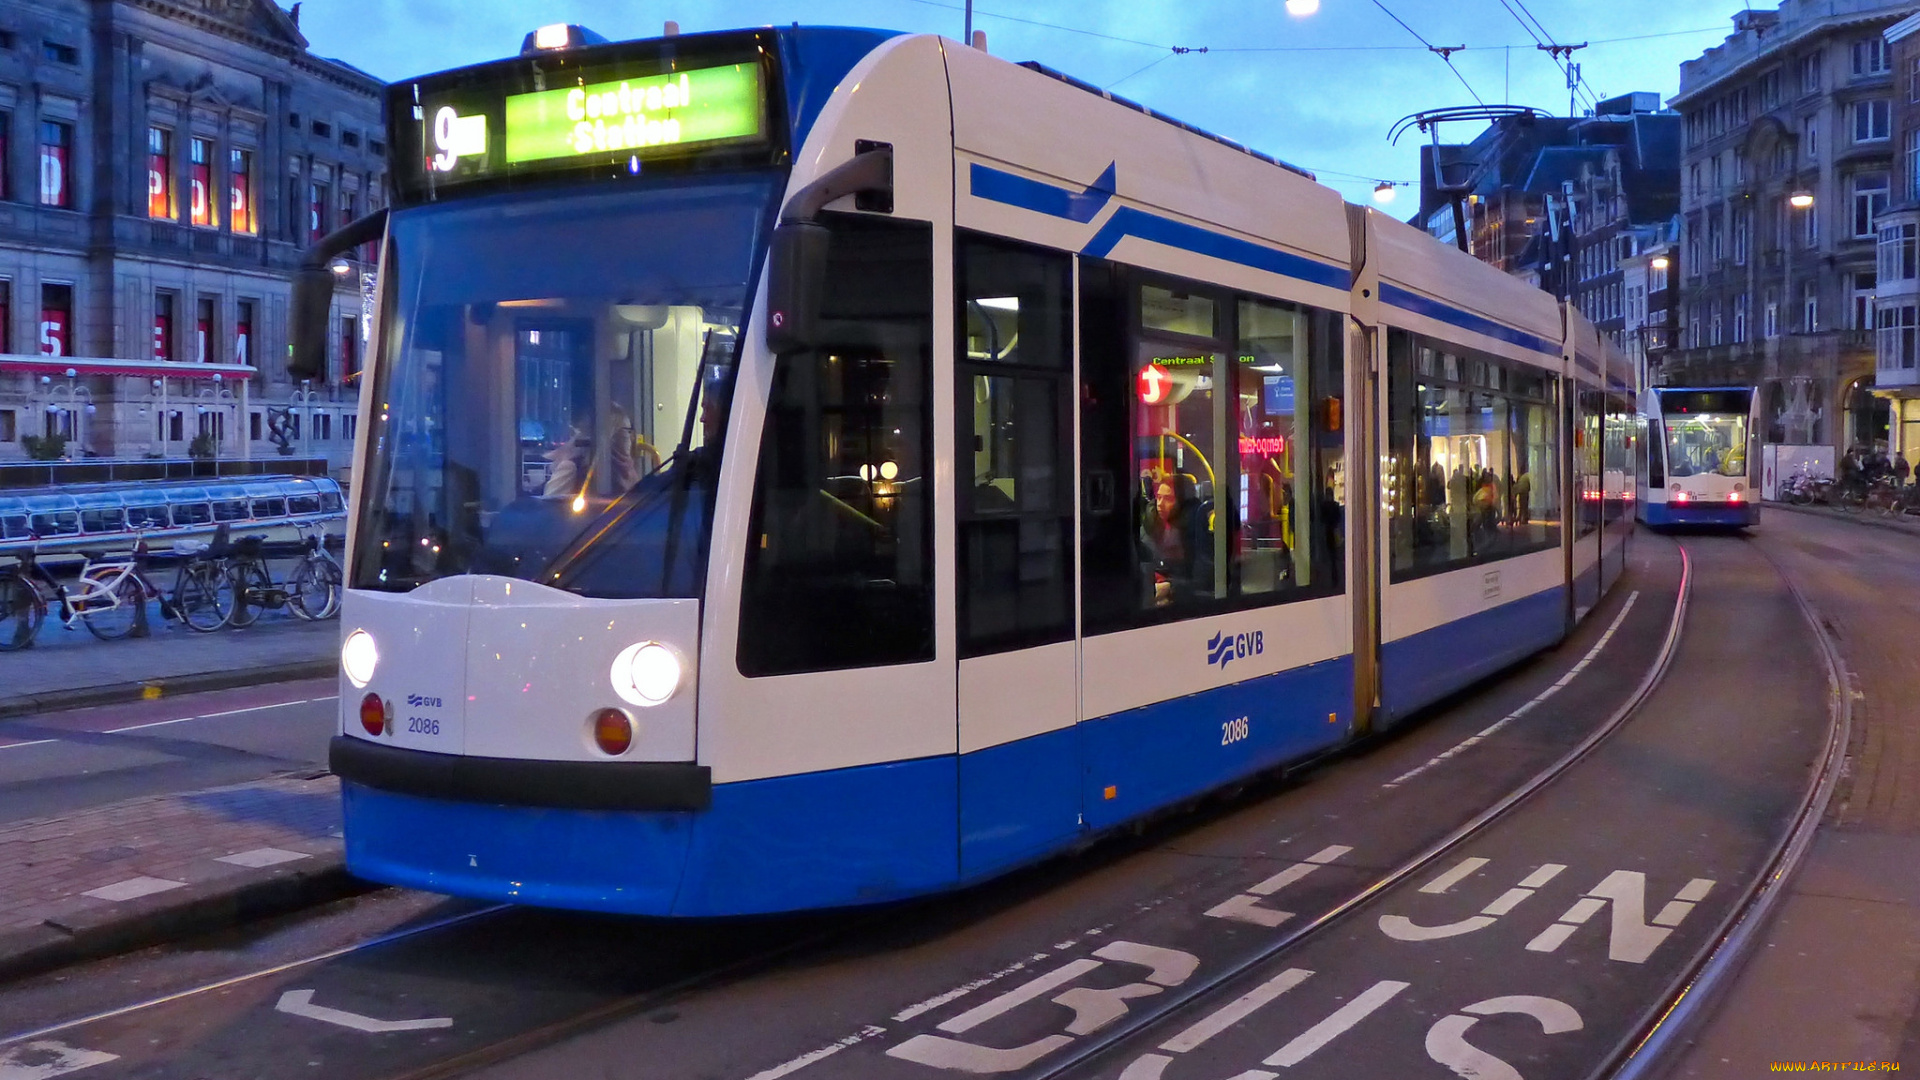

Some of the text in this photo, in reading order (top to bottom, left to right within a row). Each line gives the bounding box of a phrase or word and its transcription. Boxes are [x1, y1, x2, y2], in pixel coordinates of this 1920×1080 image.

[567, 73, 689, 120] Centraal
[434, 106, 458, 171] 9
[574, 113, 680, 153] Station
[1153, 354, 1205, 366] Centraal
[1236, 630, 1264, 659] GVB
[423, 696, 442, 707] GVB
[408, 716, 440, 735] 2086
[1221, 716, 1248, 746] 2086
